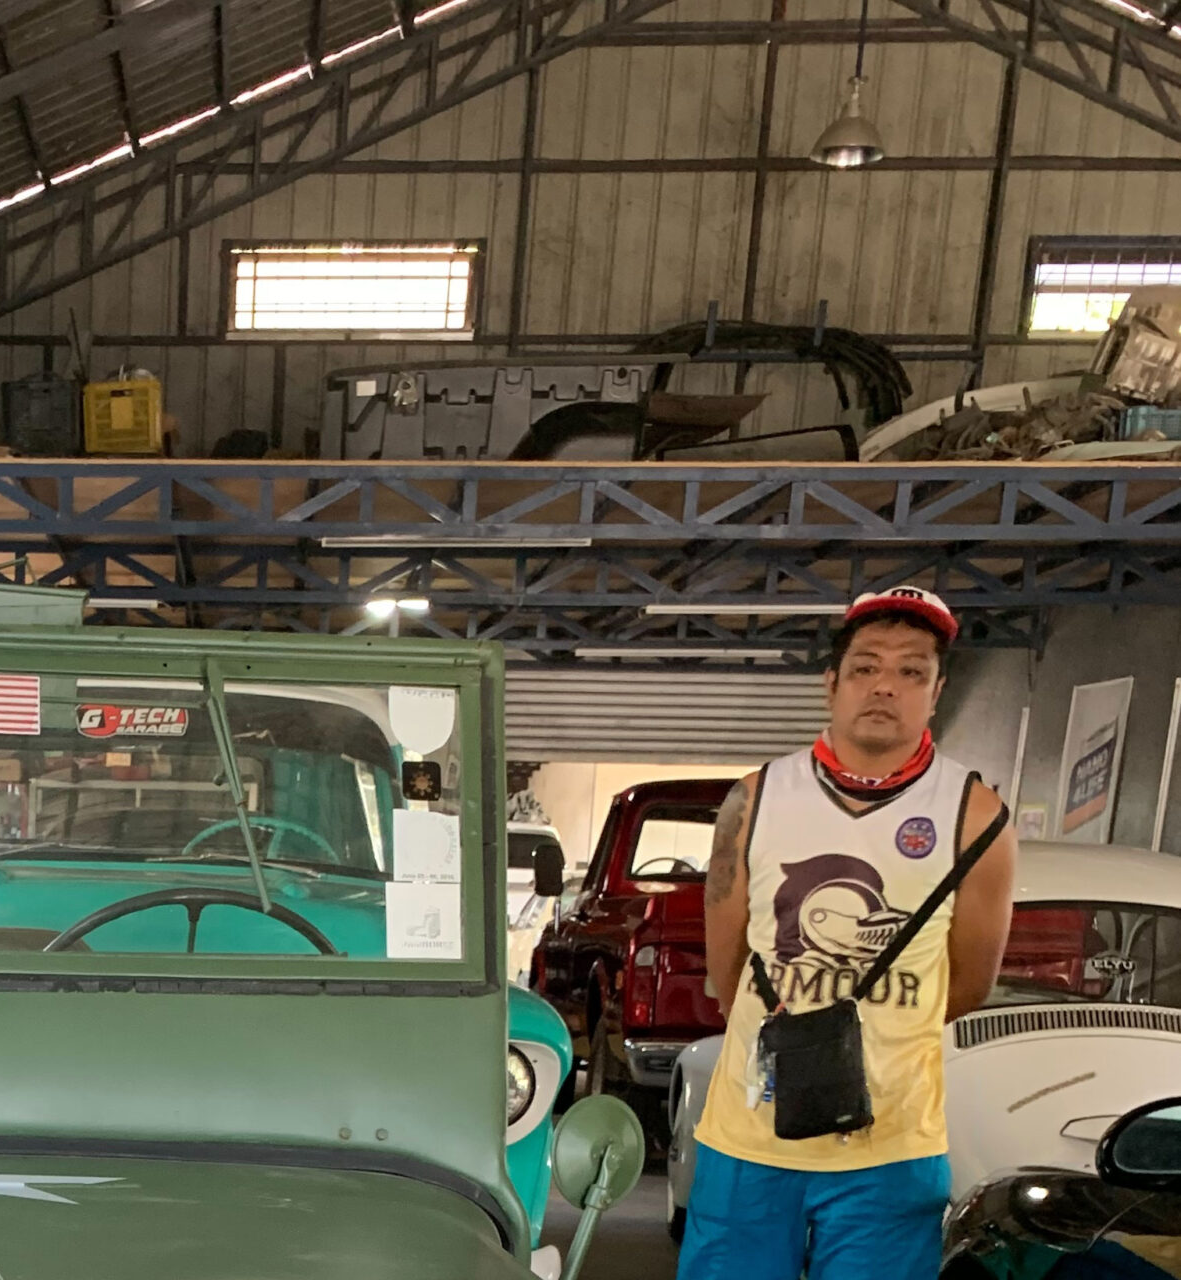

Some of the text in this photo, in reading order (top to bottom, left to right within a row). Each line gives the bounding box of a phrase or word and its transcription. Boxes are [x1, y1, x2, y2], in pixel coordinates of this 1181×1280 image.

[80, 708, 181, 728] G-TECH
[115, 724, 185, 734] GARAGE
[747, 964, 921, 1009] RMOUR
